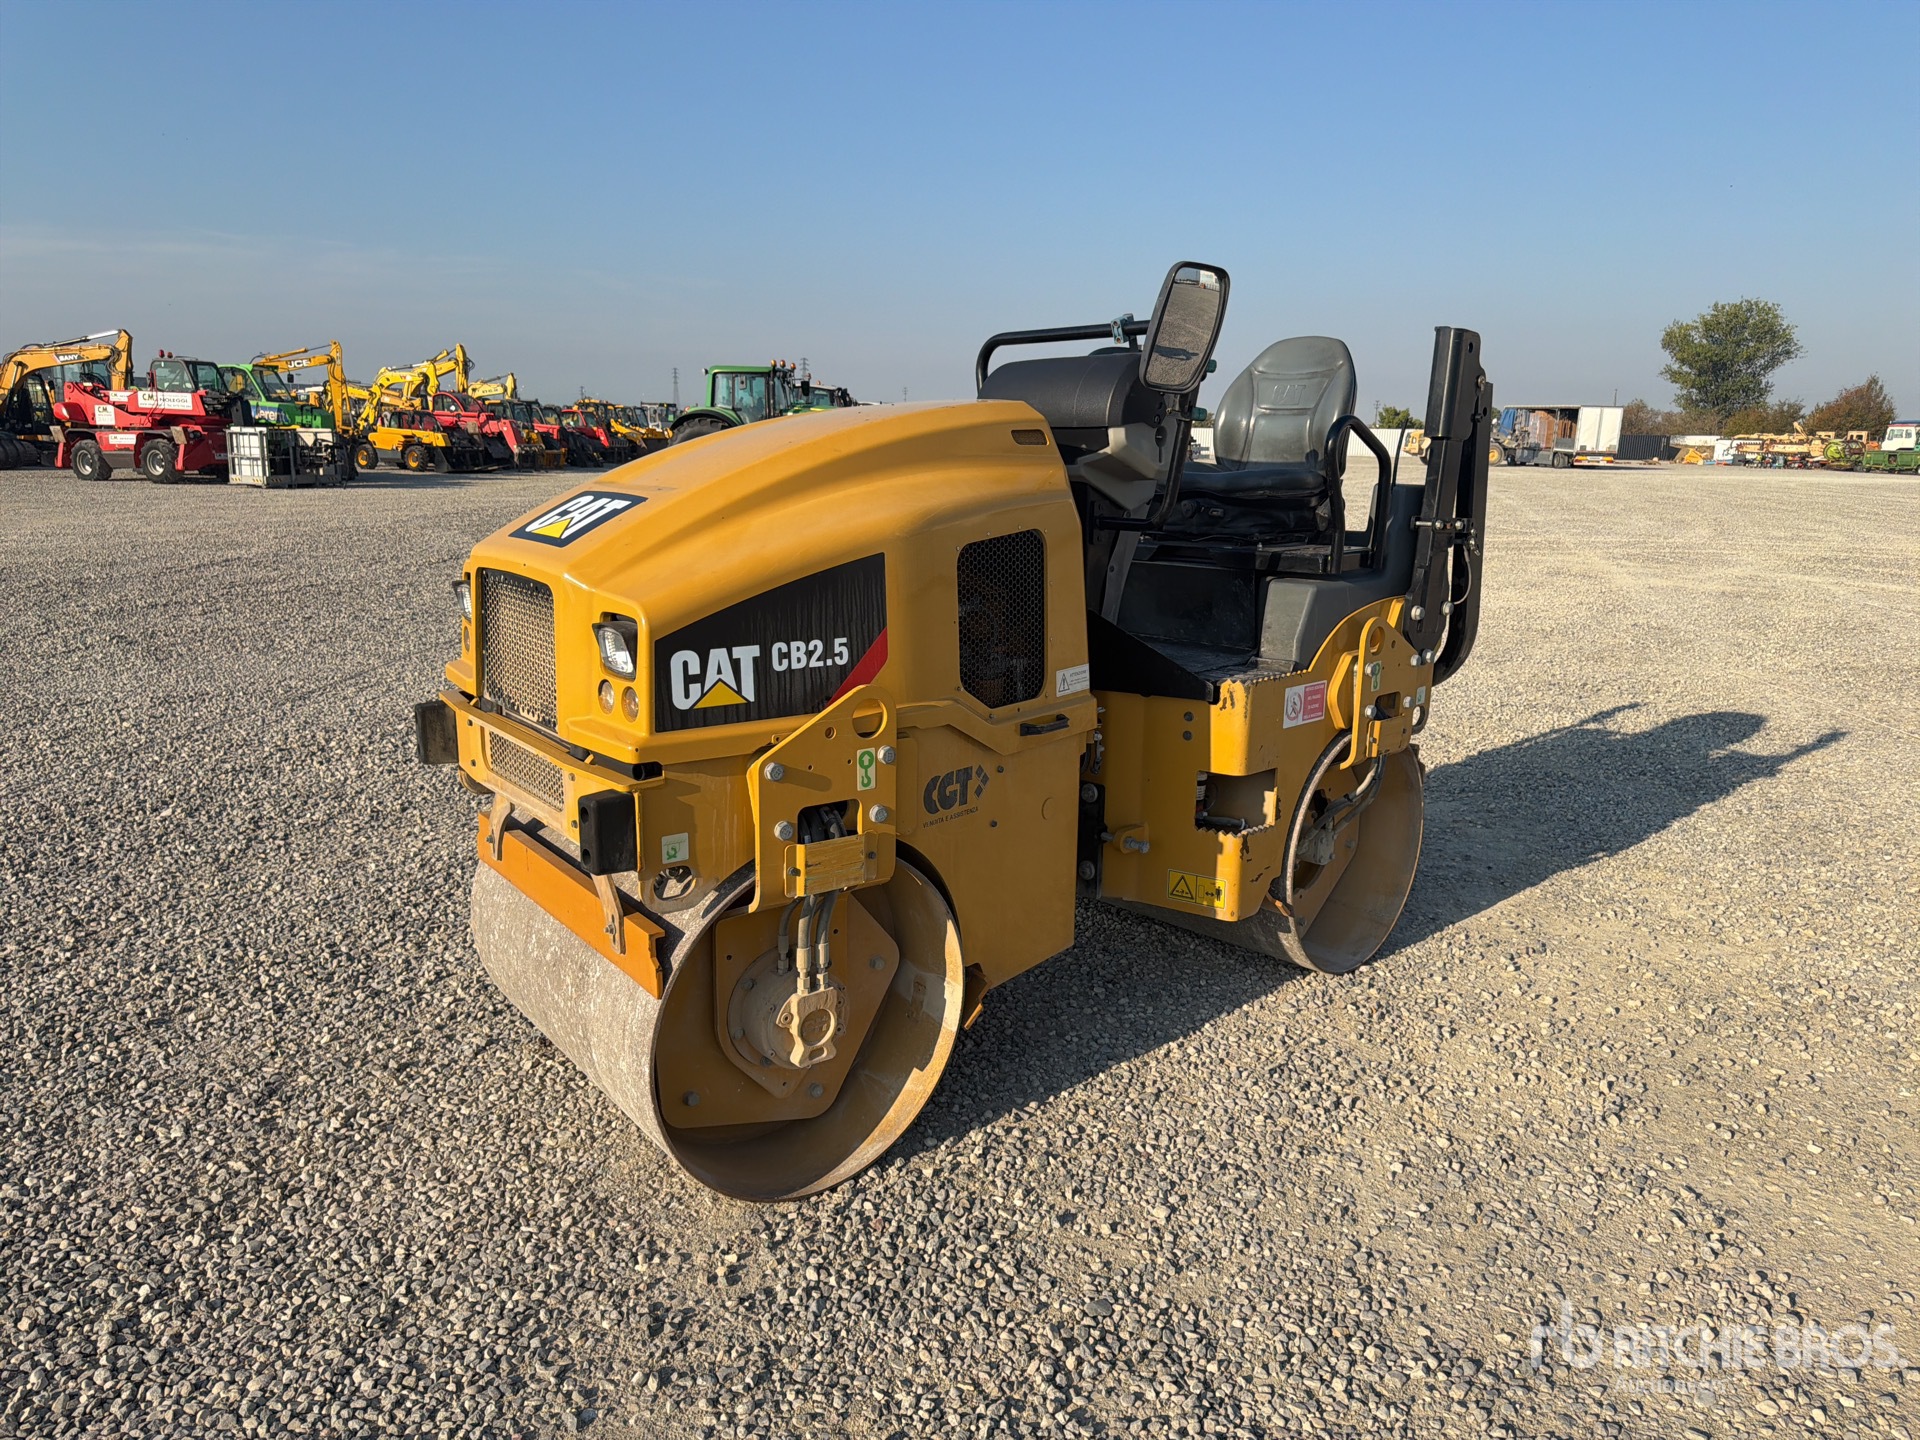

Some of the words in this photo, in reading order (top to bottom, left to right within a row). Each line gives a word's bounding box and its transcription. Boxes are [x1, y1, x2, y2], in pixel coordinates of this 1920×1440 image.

[525, 495, 632, 539] CAT
[670, 644, 760, 710] CAT
[771, 637, 849, 672] CB2.5
[923, 766, 973, 814] CGT
[922, 816, 944, 829] VENDITA
[949, 806, 979, 821] ASSISTENZA
